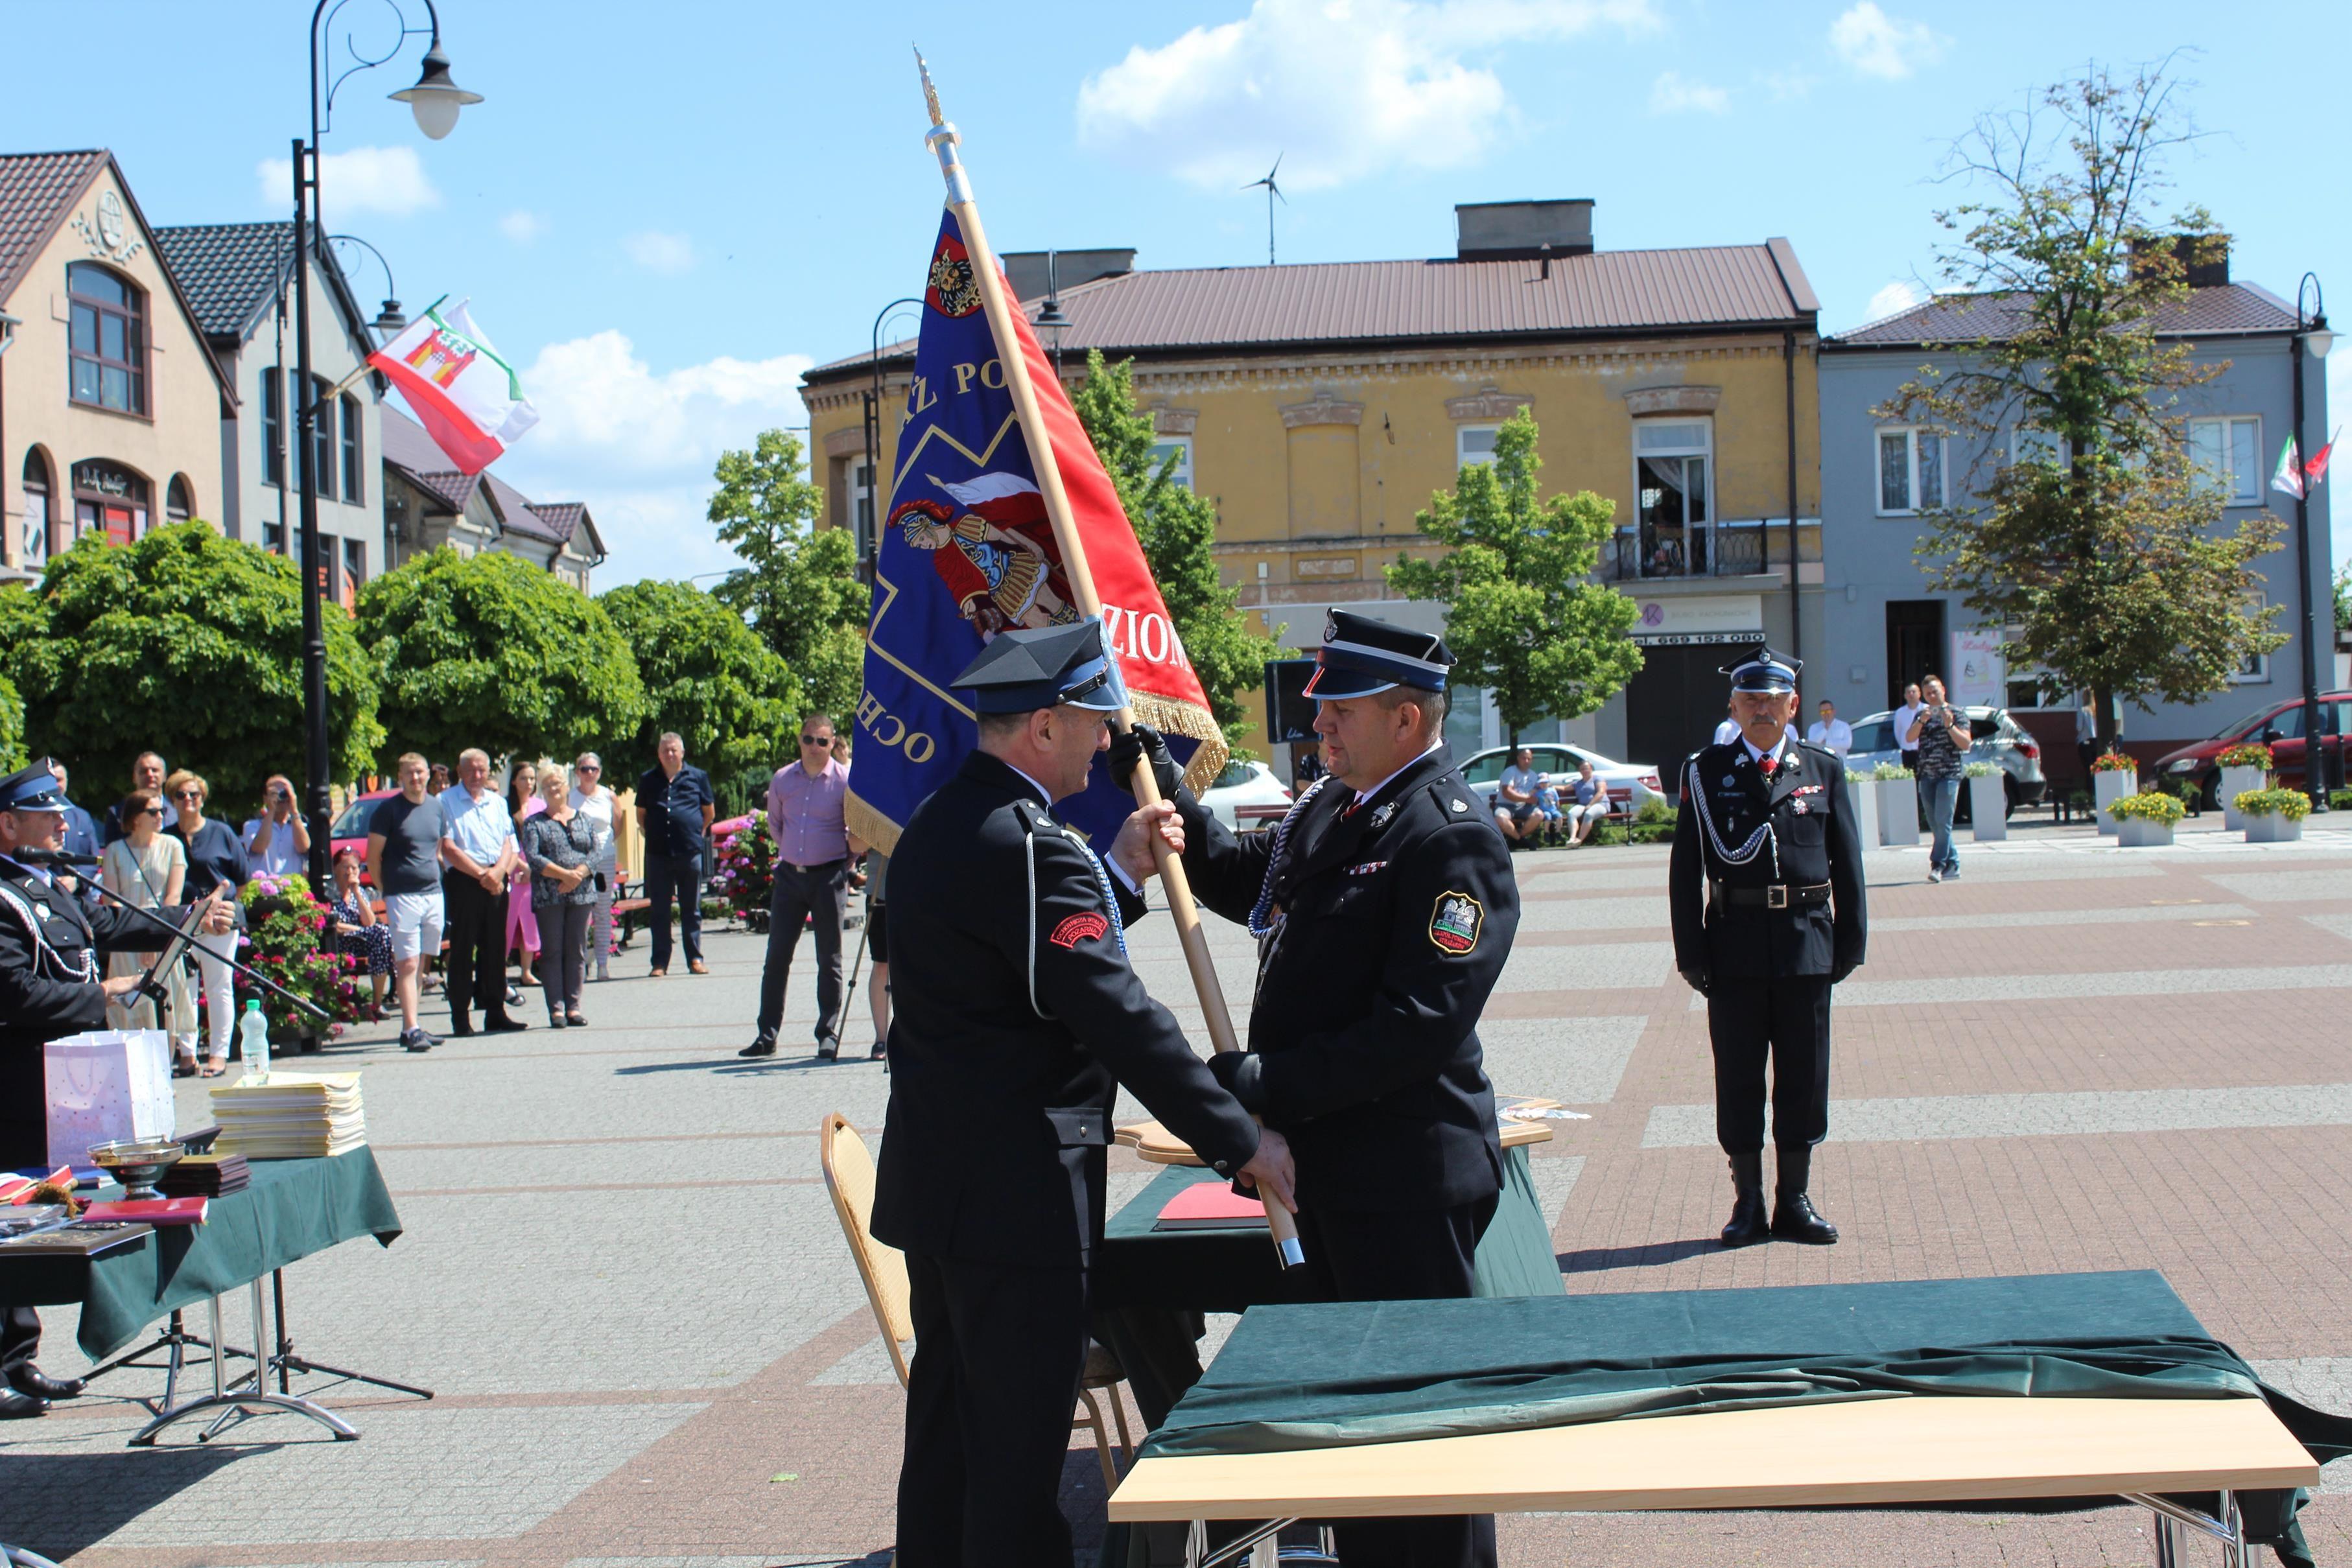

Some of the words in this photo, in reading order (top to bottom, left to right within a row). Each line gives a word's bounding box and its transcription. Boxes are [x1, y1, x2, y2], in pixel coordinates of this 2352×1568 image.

[1658, 635, 1690, 644] 669
[1697, 634, 1725, 643] 152
[1730, 633, 1763, 642] 080
[856, 690, 935, 763] OCH
